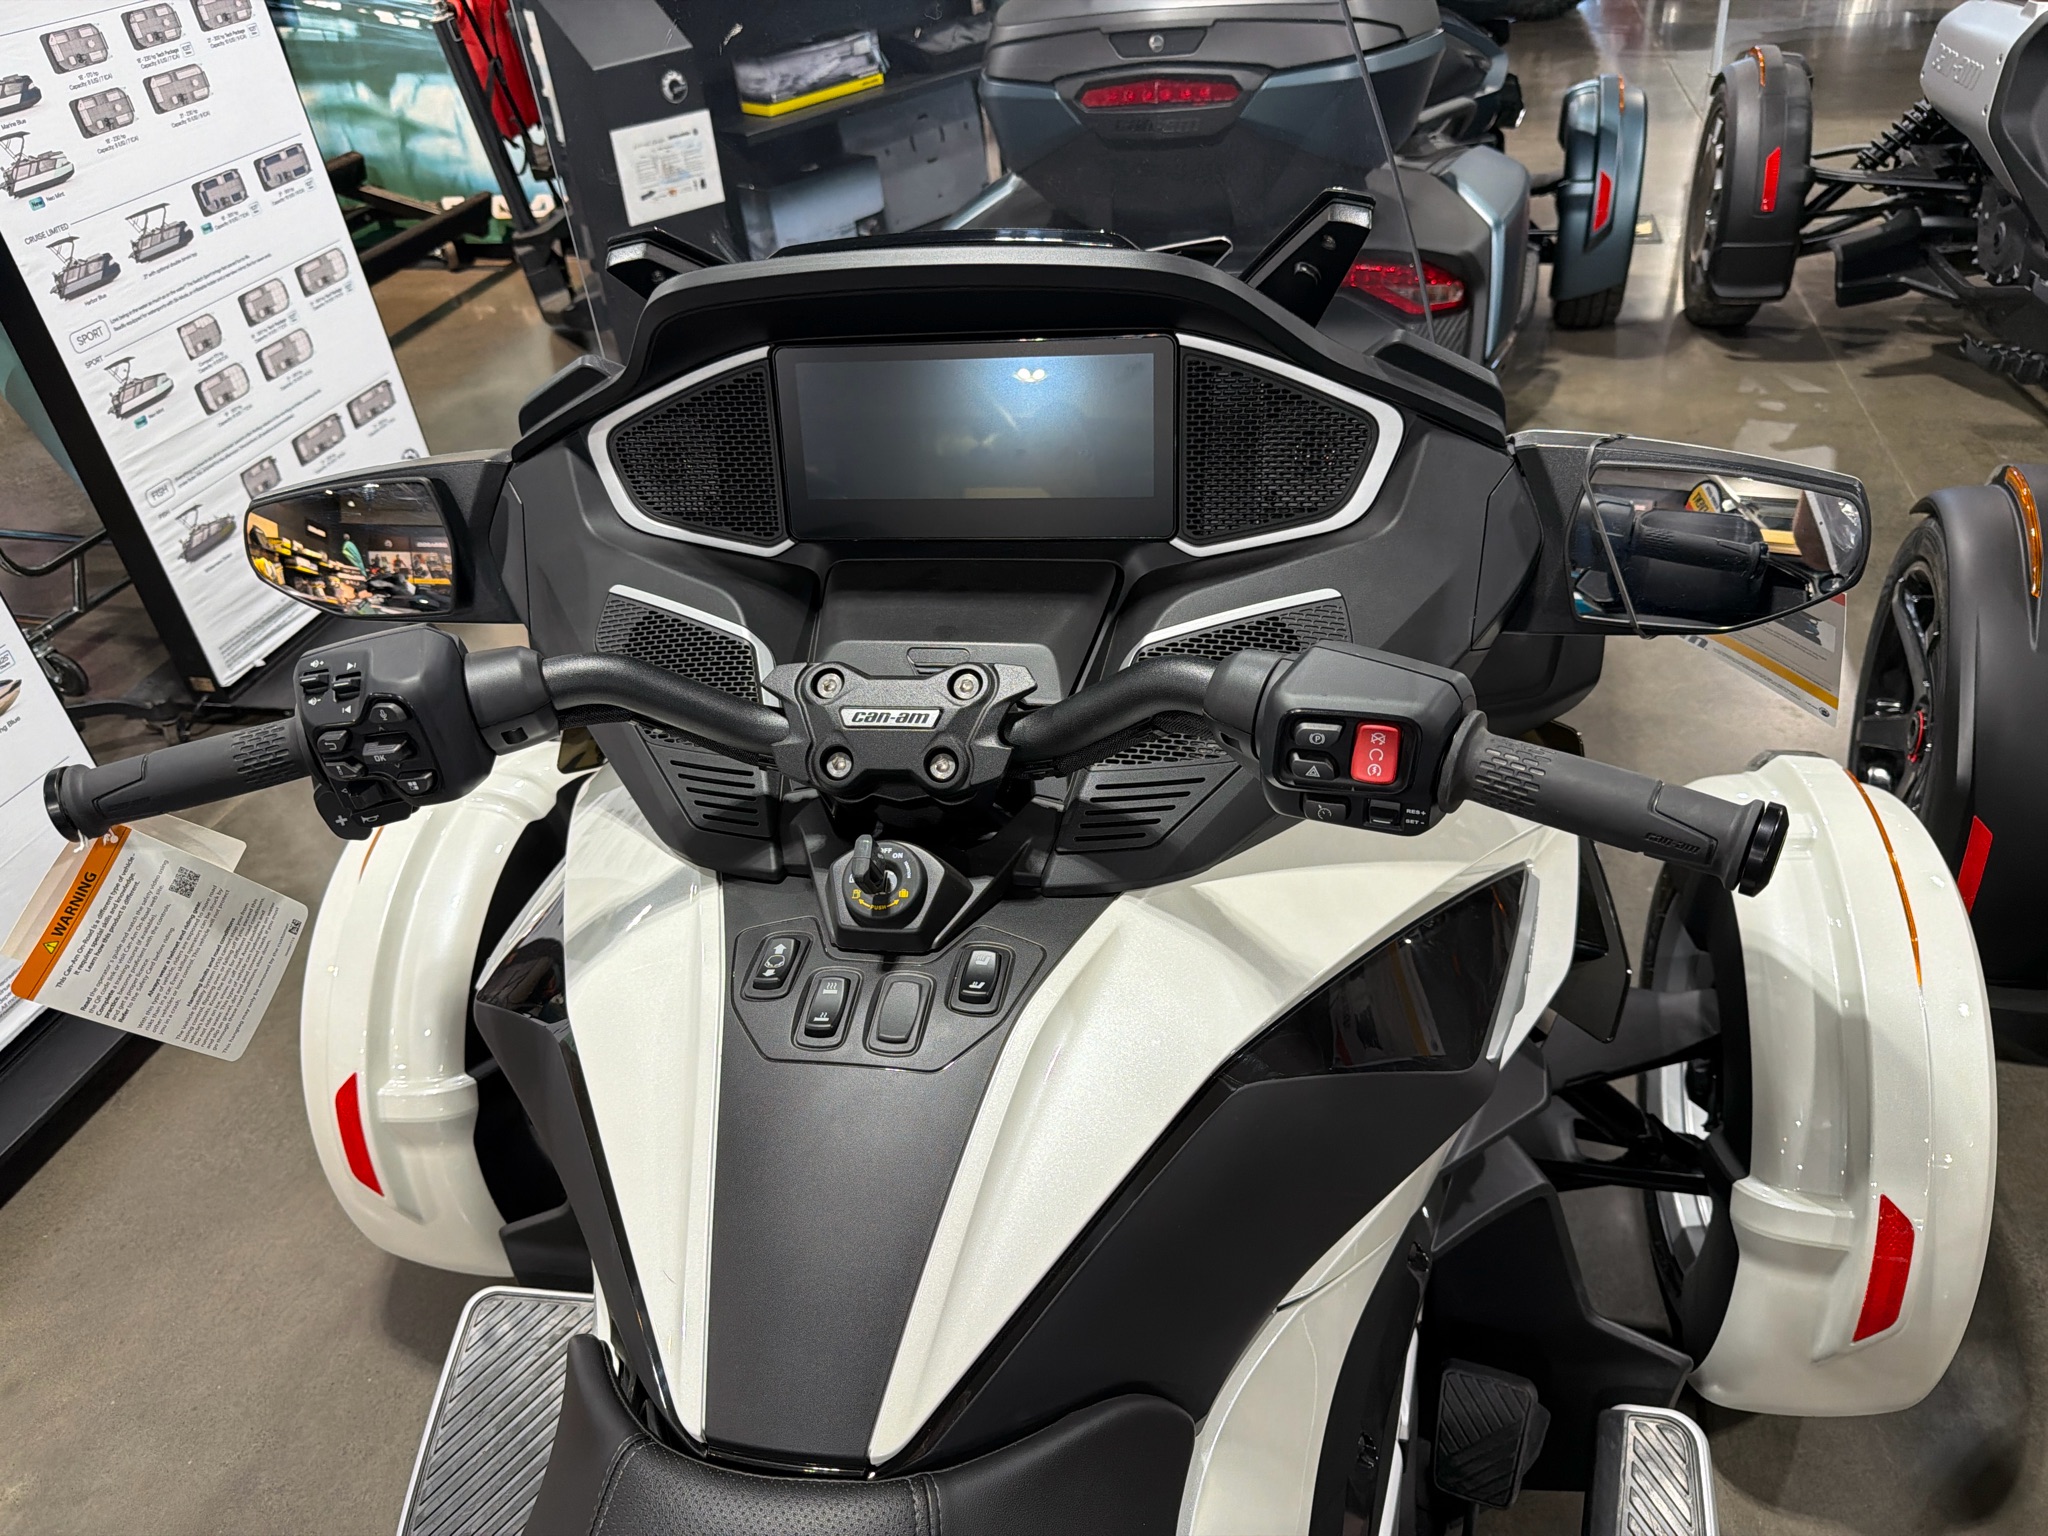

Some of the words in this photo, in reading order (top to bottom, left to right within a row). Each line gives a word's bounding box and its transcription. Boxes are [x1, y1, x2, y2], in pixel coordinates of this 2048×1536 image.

[1, 122, 16, 130] Marine
[24, 231, 47, 245] CRUISE
[45, 222, 69, 237] LIMITED
[76, 325, 103, 346] SPORT
[84, 354, 103, 369] SPORT
[150, 483, 169, 500] FISH
[7, 716, 21, 728] Blue
[374, 755, 387, 763] OK
[851, 710, 930, 724] can-am
[51, 872, 97, 936] WARNING
[55, 976, 67, 988] This
[63, 953, 80, 976] Can-Am
[76, 928, 95, 954] On-Road
[97, 895, 114, 919] different
[110, 882, 120, 895] type
[121, 856, 135, 875] vehicle
[77, 947, 94, 970] requires
[90, 927, 104, 948] special
[101, 914, 112, 928] skills
[109, 902, 118, 915] and
[114, 872, 136, 903] knowledge.
[79, 996, 92, 1011] Read
[89, 987, 98, 997] the
[95, 959, 114, 987] operator's
[111, 943, 123, 959] guide
[120, 931, 129, 943] and
[126, 915, 138, 932] watch
[135, 905, 144, 915] the
[141, 889, 153, 906] safety
[149, 874, 160, 889] video
[158, 859, 170, 875] using
[84, 956, 98, 972] Learn
[93, 943, 105, 956] how
[101, 932, 111, 943] this
[108, 910, 124, 933] product
[123, 880, 140, 905] different.
[147, 978, 161, 997] Always
[158, 964, 168, 978] wear
[166, 940, 181, 960] helmet
[178, 929, 186, 941] and
[183, 913, 196, 930] riding
[192, 901, 202, 914] gear.
[88, 1004, 97, 1014] the
[93, 994, 102, 1004] QR
[100, 981, 111, 995] code
[107, 970, 117, 981] link
[117, 952, 127, 964] visit
[123, 931, 139, 953] Can-Am
[135, 906, 151, 931] On-Road
[149, 895, 158, 907] web
[155, 885, 164, 895] site.
[95, 989, 115, 1016] Complete
[114, 963, 130, 985] training
[126, 945, 139, 964] course
[140, 914, 158, 940] available),
[111, 1009, 120, 1021] and
[118, 1000, 126, 1010] get
[126, 977, 138, 996] proper
[135, 957, 150, 977] licence.
[117, 1008, 129, 1023] Refer
[130, 992, 139, 1002] the
[135, 974, 149, 991] Safety
[145, 961, 156, 975] Card
[152, 943, 165, 961] before
[163, 927, 175, 943] riding.
[137, 1015, 148, 1028] With
[145, 1005, 154, 1015] this
[151, 992, 161, 1005] type
[161, 966, 176, 985] vehicle,
[173, 950, 184, 965] riders
[186, 918, 200, 941] exposed
[201, 897, 211, 912] more
[208, 884, 217, 897] road
[145, 1019, 155, 1031] risks
[151, 1005, 162, 1018] than
[165, 986, 173, 995] car.
[169, 972, 180, 985] Even
[177, 954, 189, 972] skilled
[186, 929, 202, 954] operators
[204, 911, 211, 919] be
[209, 895, 219, 911] struck
[216, 887, 223, 895] by
[152, 1018, 162, 1033] other
[160, 996, 174, 1018] vehicles
[174, 978, 184, 990] lose
[182, 956, 195, 978] control.
[191, 947, 201, 958] This
[198, 928, 210, 946] vehicle
[208, 917, 216, 928] will
[213, 908, 221, 918] not
[217, 889, 230, 909] protect
[186, 982, 203, 1007] Handling
[198, 968, 210, 982] limits
[207, 956, 215, 968] and
[213, 944, 222, 957] road
[219, 917, 236, 944] conditions
[158, 1024, 167, 1035] you
[170, 998, 181, 1014] crash.
